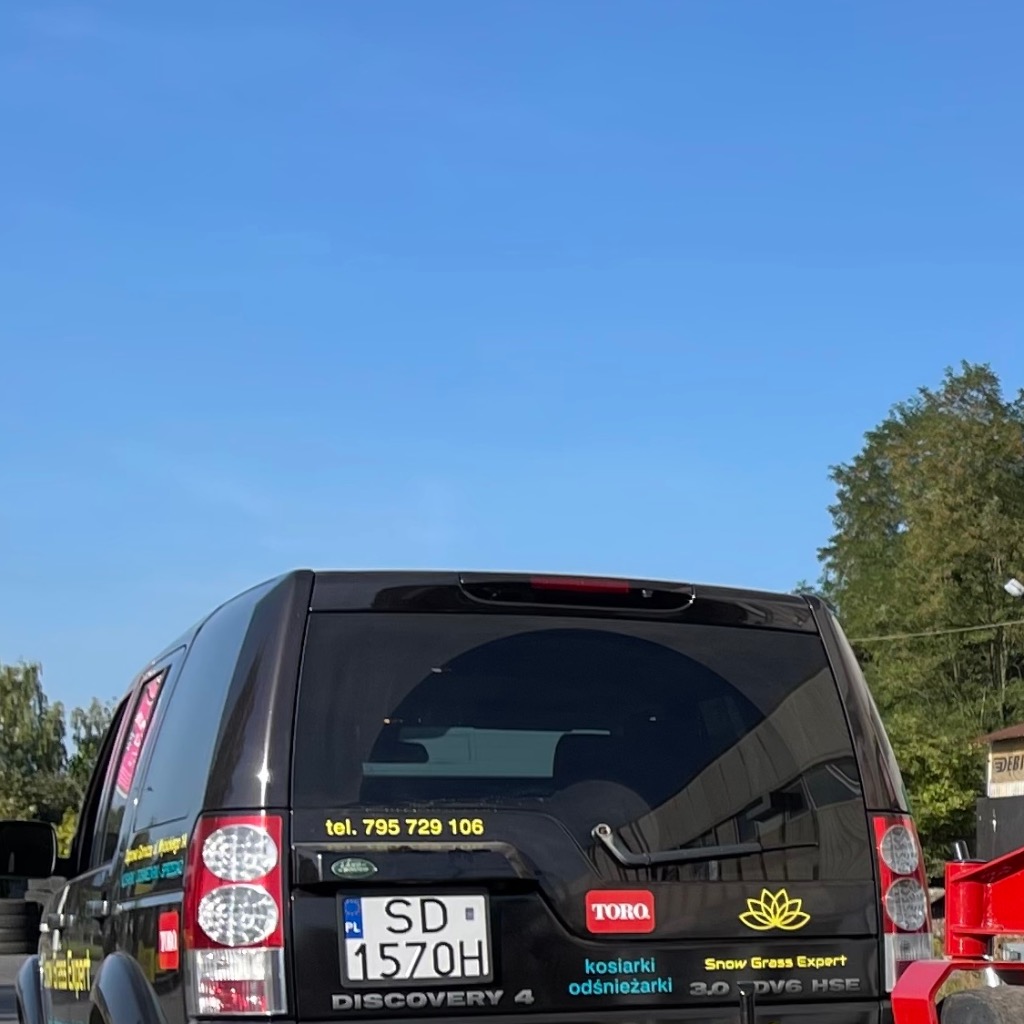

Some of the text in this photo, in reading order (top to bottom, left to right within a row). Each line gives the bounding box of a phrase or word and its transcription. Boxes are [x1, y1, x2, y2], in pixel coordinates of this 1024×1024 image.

[326, 818, 484, 836] tel. 795 729 106
[345, 898, 448, 933] PL SD
[591, 903, 651, 920] TORO
[354, 939, 485, 980] 1570H
[585, 957, 656, 975] kosiarki
[704, 955, 848, 971] Snow Grass Expert
[568, 977, 673, 995] odśnieżarki
[689, 978, 861, 996] 3.0 DV6 HSE
[331, 989, 535, 1011] DISCOVERY 4
